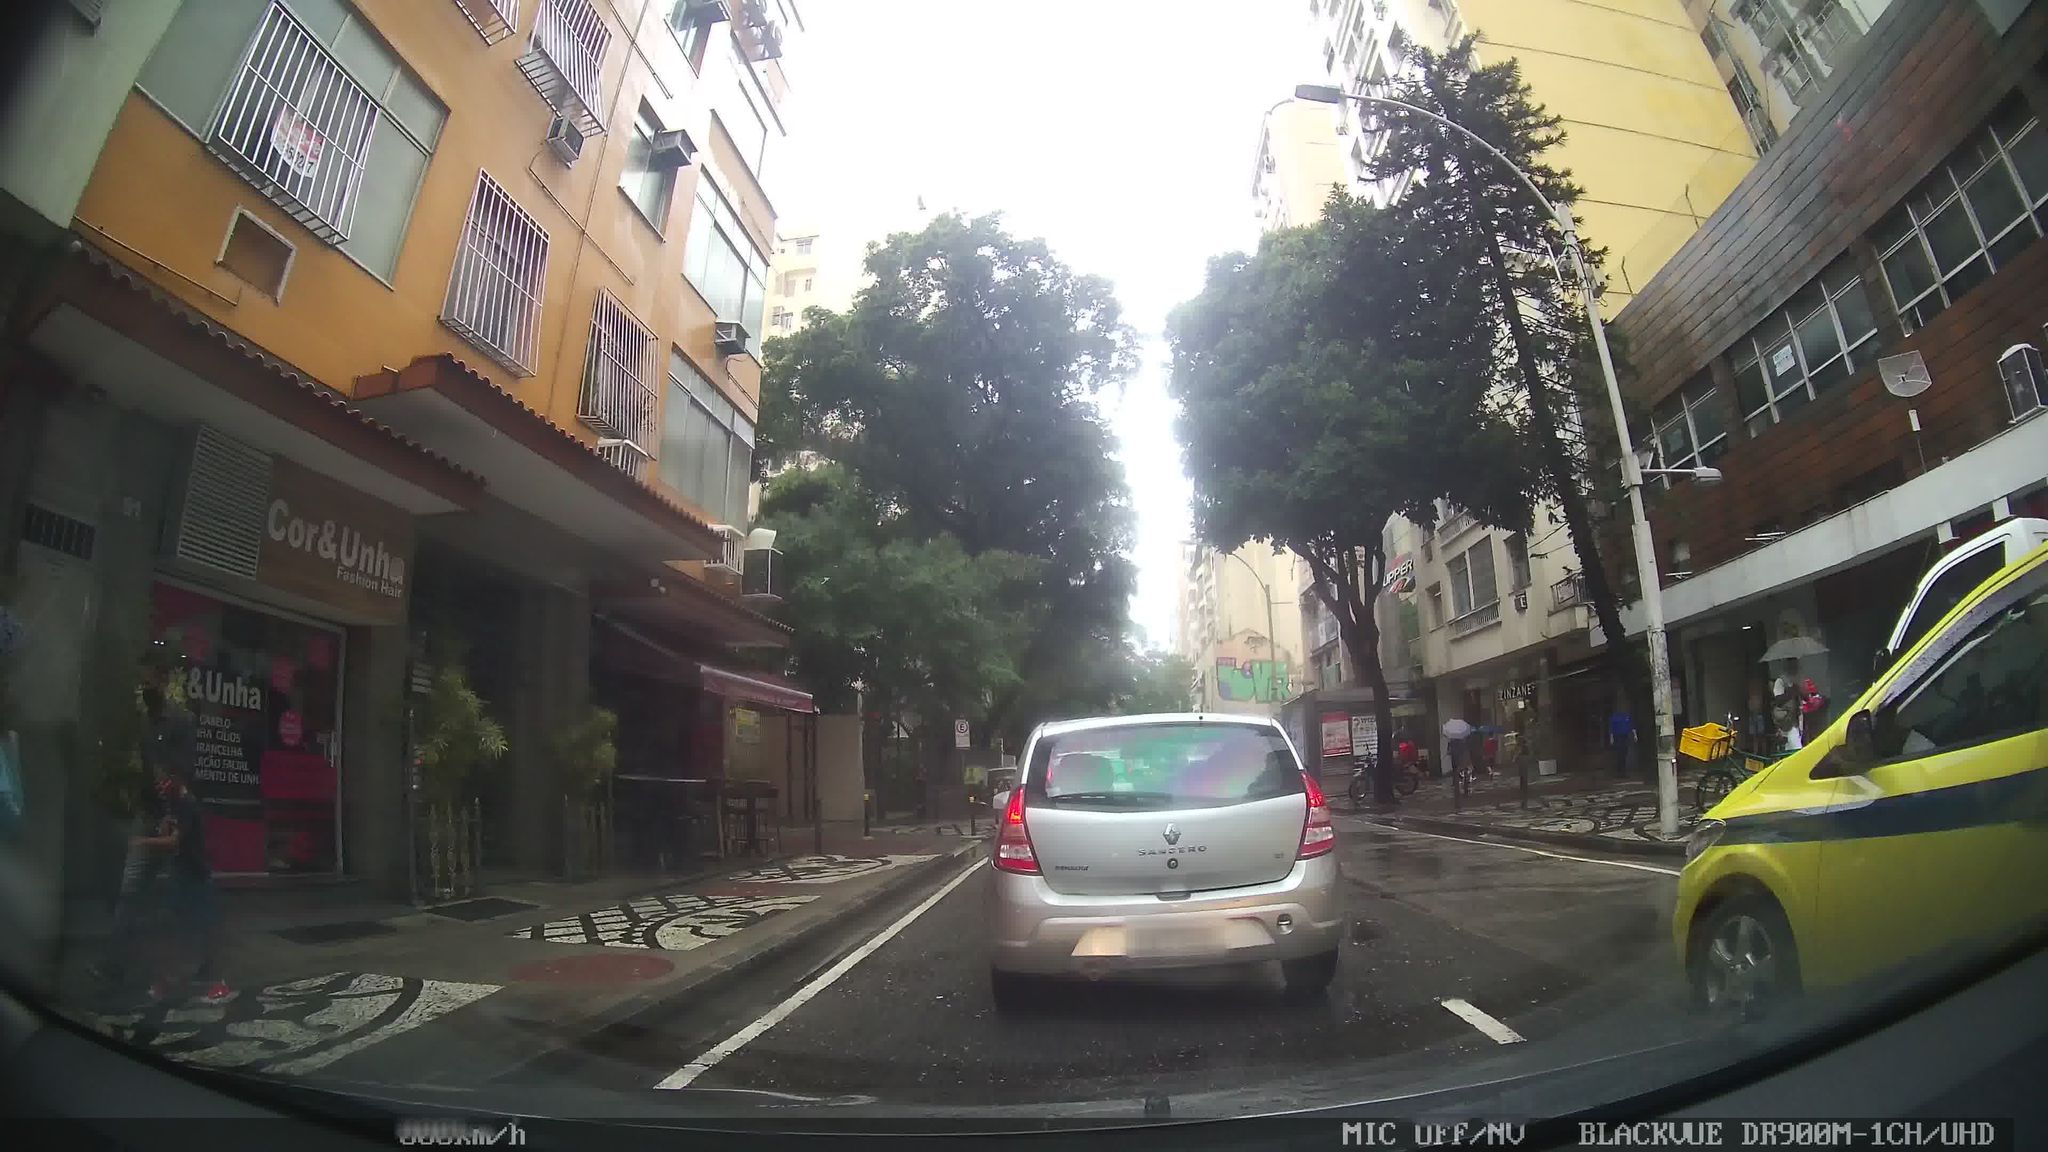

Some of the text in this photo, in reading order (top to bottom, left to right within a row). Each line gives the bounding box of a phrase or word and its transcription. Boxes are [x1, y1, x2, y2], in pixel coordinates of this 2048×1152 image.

[268, 499, 405, 585] Cor&Unha
[336, 565, 402, 599] Fashion Hair
[1382, 559, 1413, 587] UPPER
[1138, 845, 1207, 857] SANDERO
